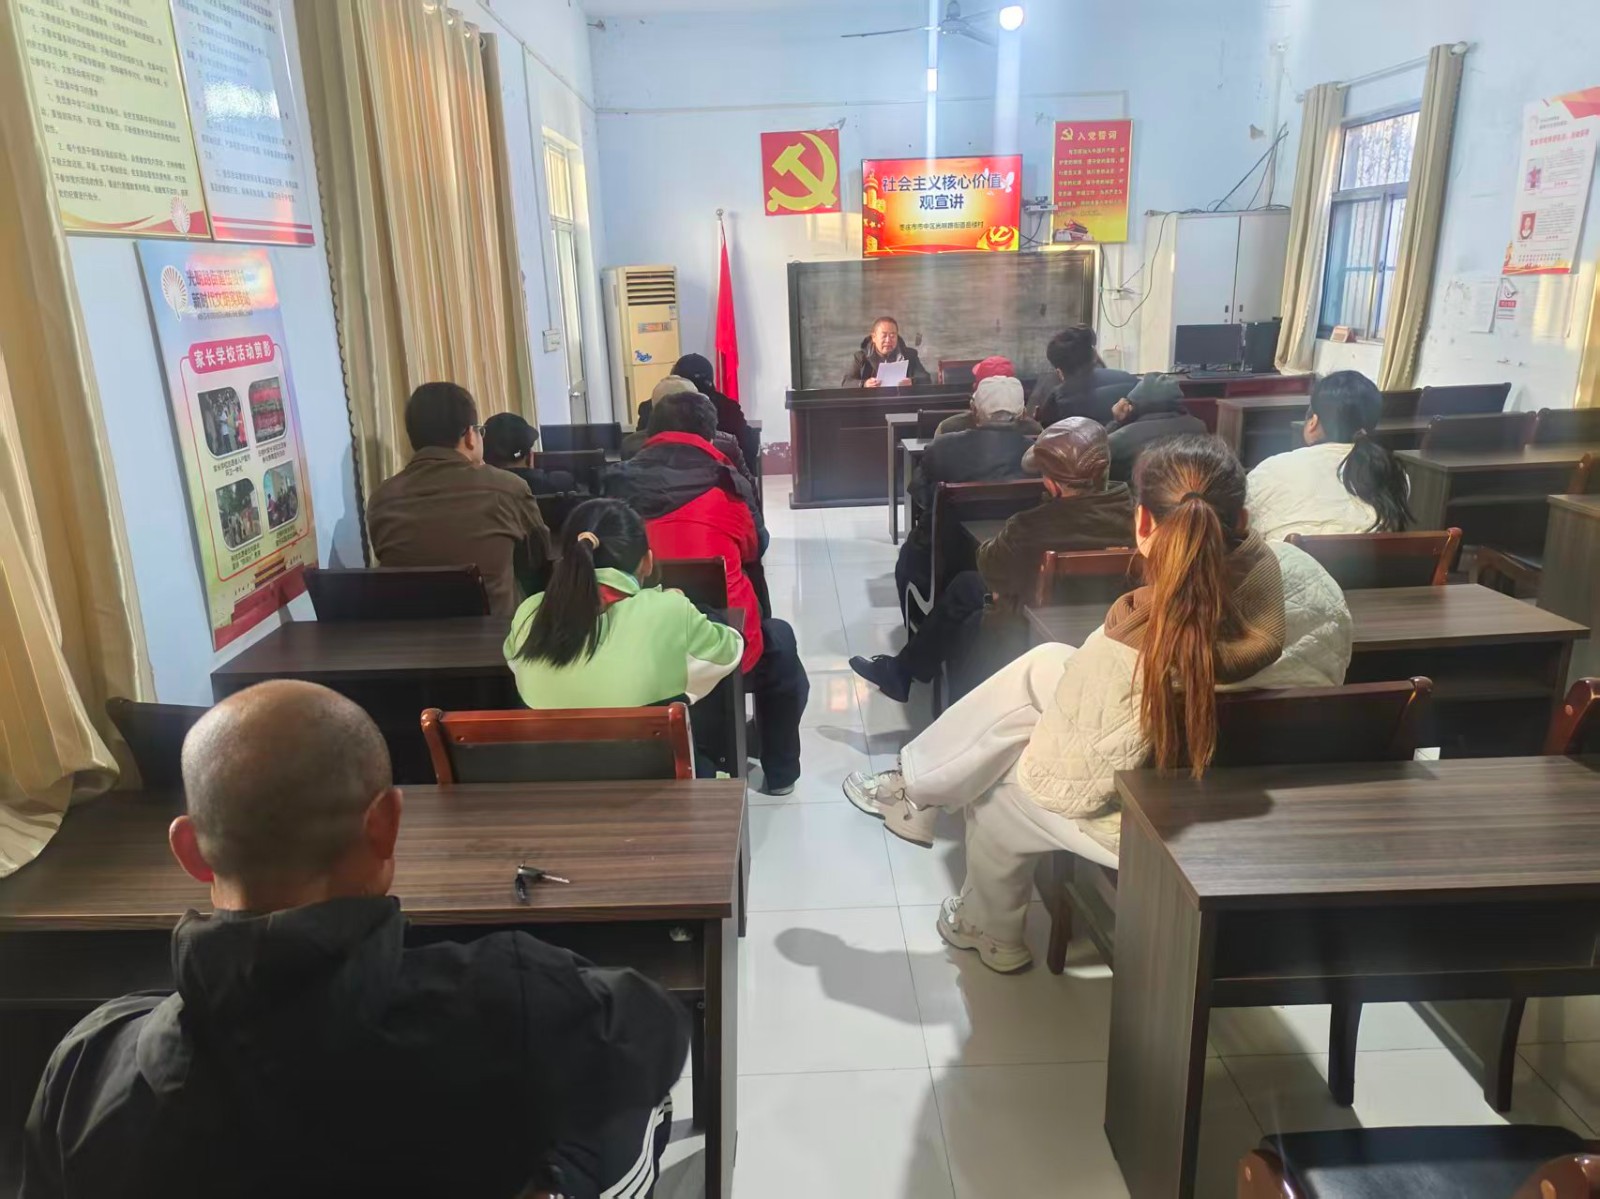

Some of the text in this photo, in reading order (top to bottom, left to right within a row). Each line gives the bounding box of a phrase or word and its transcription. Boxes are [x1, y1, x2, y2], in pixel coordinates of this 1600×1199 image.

[1077, 130, 1117, 141] 入党誓词
[883, 173, 1001, 192] 社会主义核心价值
[919, 194, 964, 210] 观宣讲
[194, 341, 271, 368] 家长学校活动剪影
